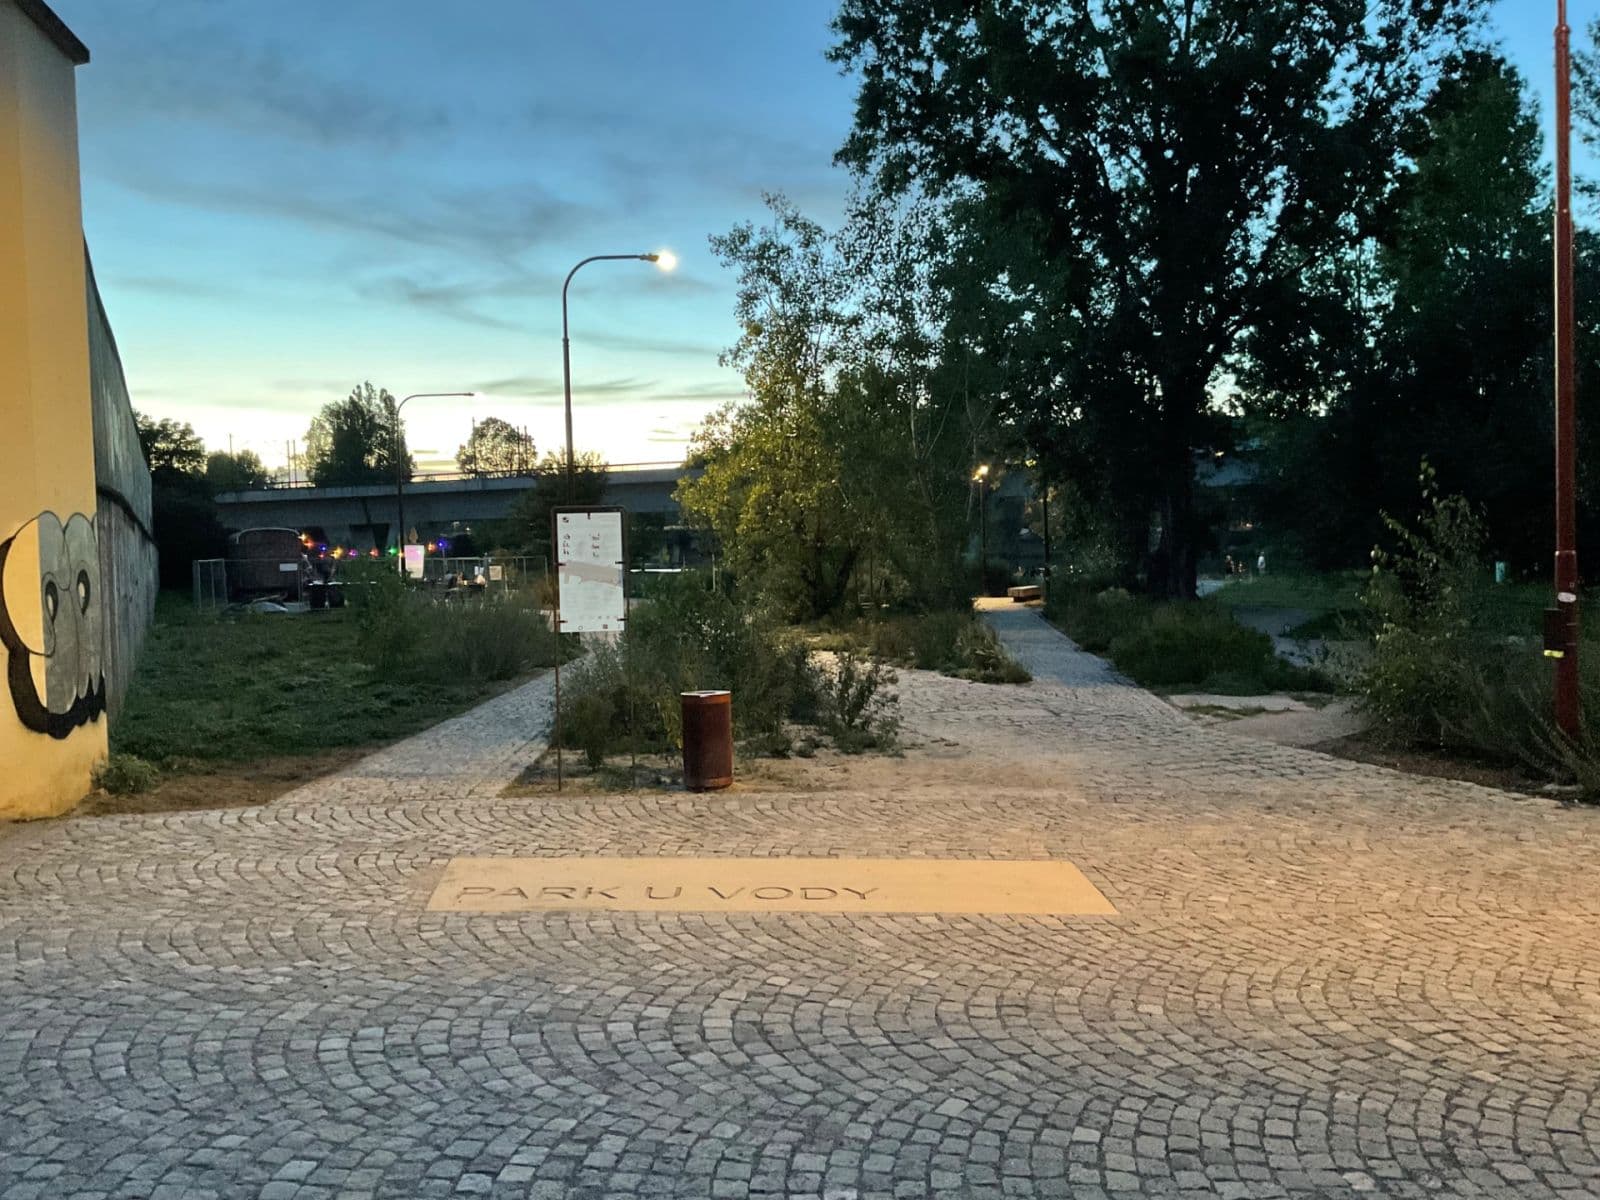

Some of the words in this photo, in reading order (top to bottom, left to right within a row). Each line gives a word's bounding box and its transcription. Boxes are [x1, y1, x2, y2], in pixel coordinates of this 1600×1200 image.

[456, 886, 622, 900] PARK
[646, 886, 682, 900] U
[707, 886, 880, 901] VODY
